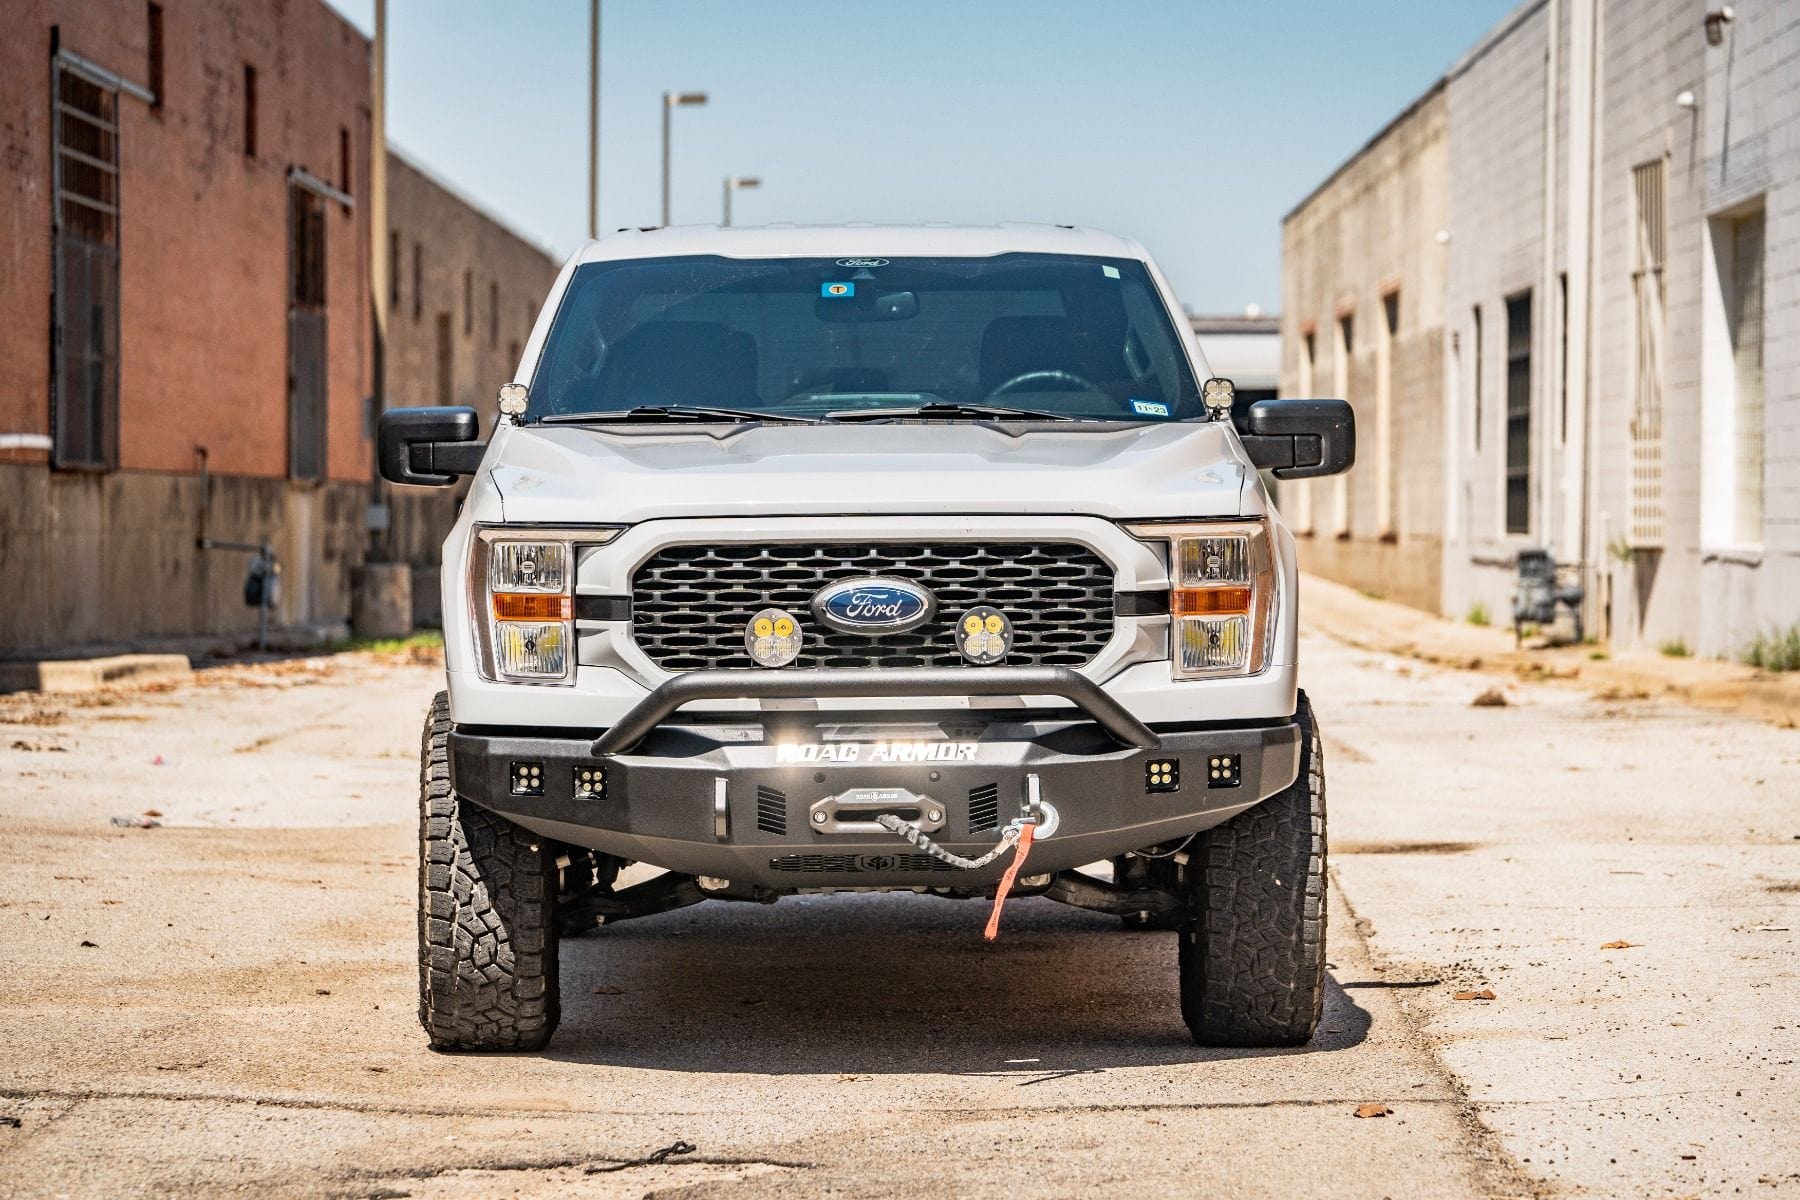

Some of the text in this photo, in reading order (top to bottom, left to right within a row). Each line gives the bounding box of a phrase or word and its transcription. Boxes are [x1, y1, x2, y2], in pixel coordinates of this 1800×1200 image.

[845, 257, 880, 266] Ford
[846, 593, 903, 617] Ford
[868, 742, 978, 761] ARMOR
